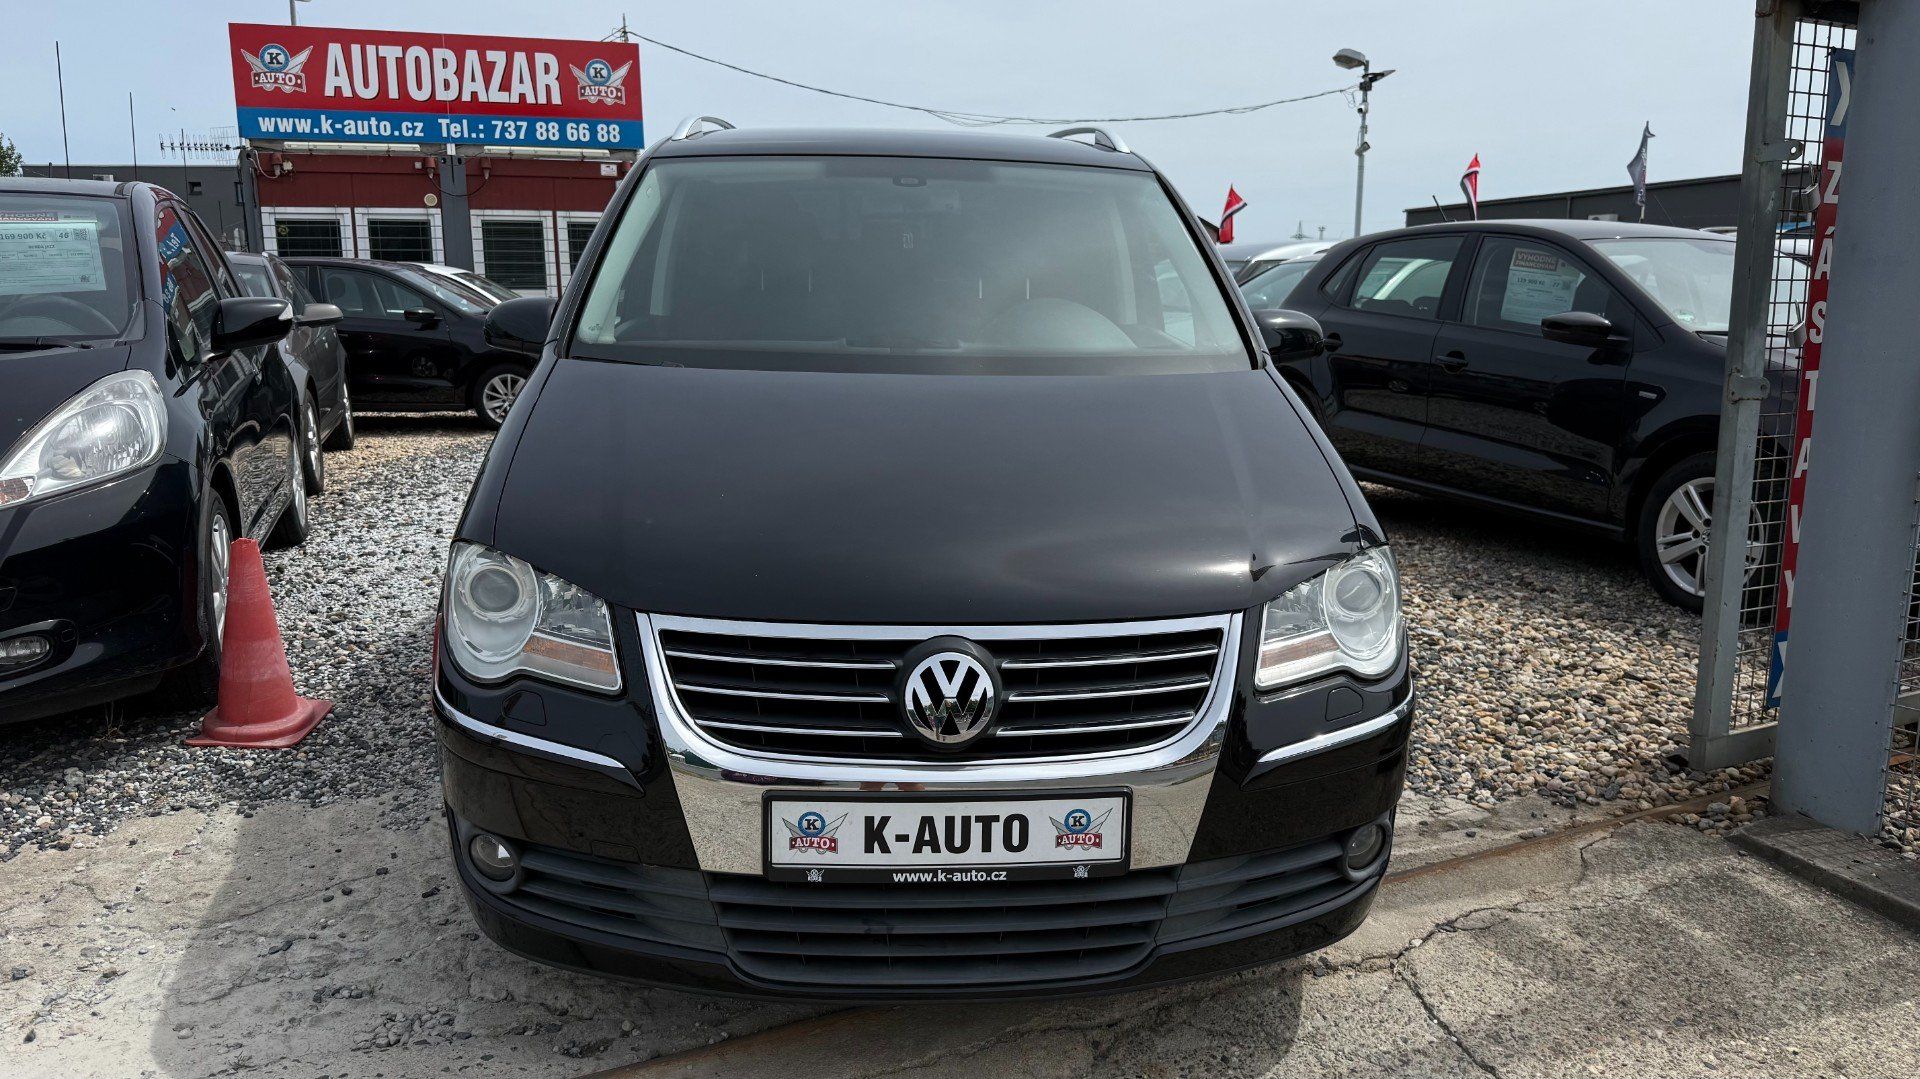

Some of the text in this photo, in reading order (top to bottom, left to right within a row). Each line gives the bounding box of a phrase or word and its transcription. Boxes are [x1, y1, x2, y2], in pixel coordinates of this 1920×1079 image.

[266, 52, 283, 65] K
[324, 42, 563, 105] AUTOBAZAR
[592, 66, 605, 79] K
[259, 72, 297, 87] AUTO
[584, 85, 617, 98] AUTO
[258, 114, 621, 143] www.k-auto.cz Tel.: 737 88 66 88
[905, 652, 994, 743] VW
[805, 818, 819, 831] K
[1071, 815, 1085, 827] K
[864, 814, 1029, 854] K-AUTO
[1060, 834, 1096, 846] AUTO
[795, 837, 830, 849] AUTO
[893, 869, 1007, 882] www.k-auto.cz
